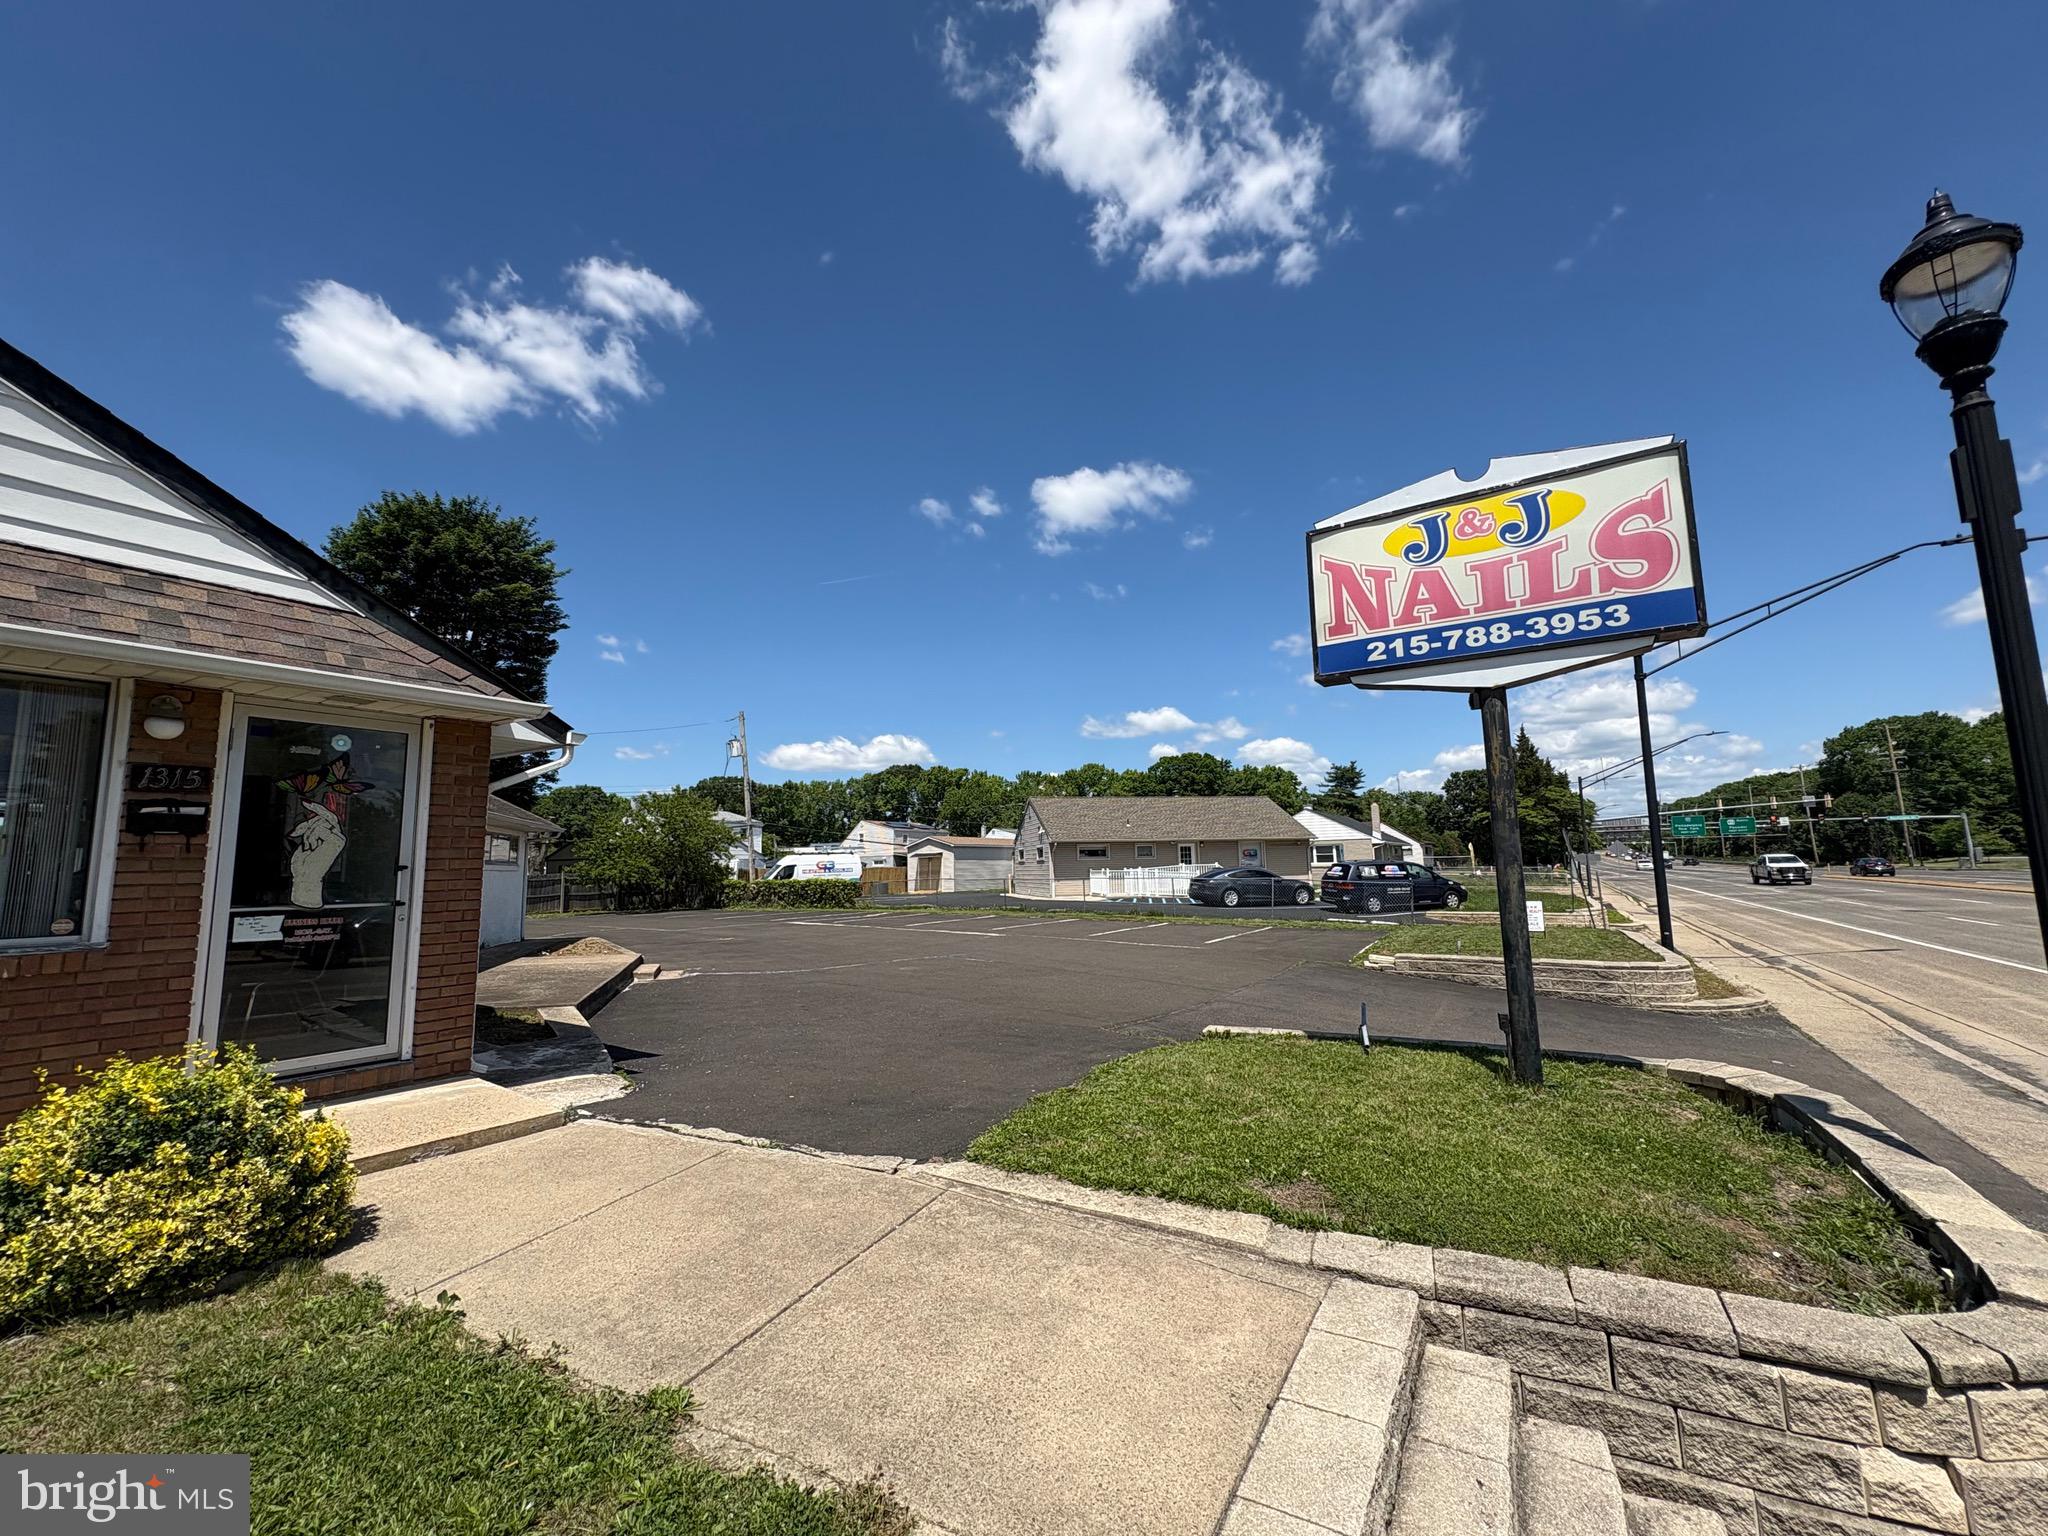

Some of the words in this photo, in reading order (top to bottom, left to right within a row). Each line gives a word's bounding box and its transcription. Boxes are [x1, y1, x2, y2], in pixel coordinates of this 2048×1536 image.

[1320, 478, 1681, 642] NAILS
[1366, 603, 1632, 663] 215-788-3953
[137, 766, 202, 789] 1315
